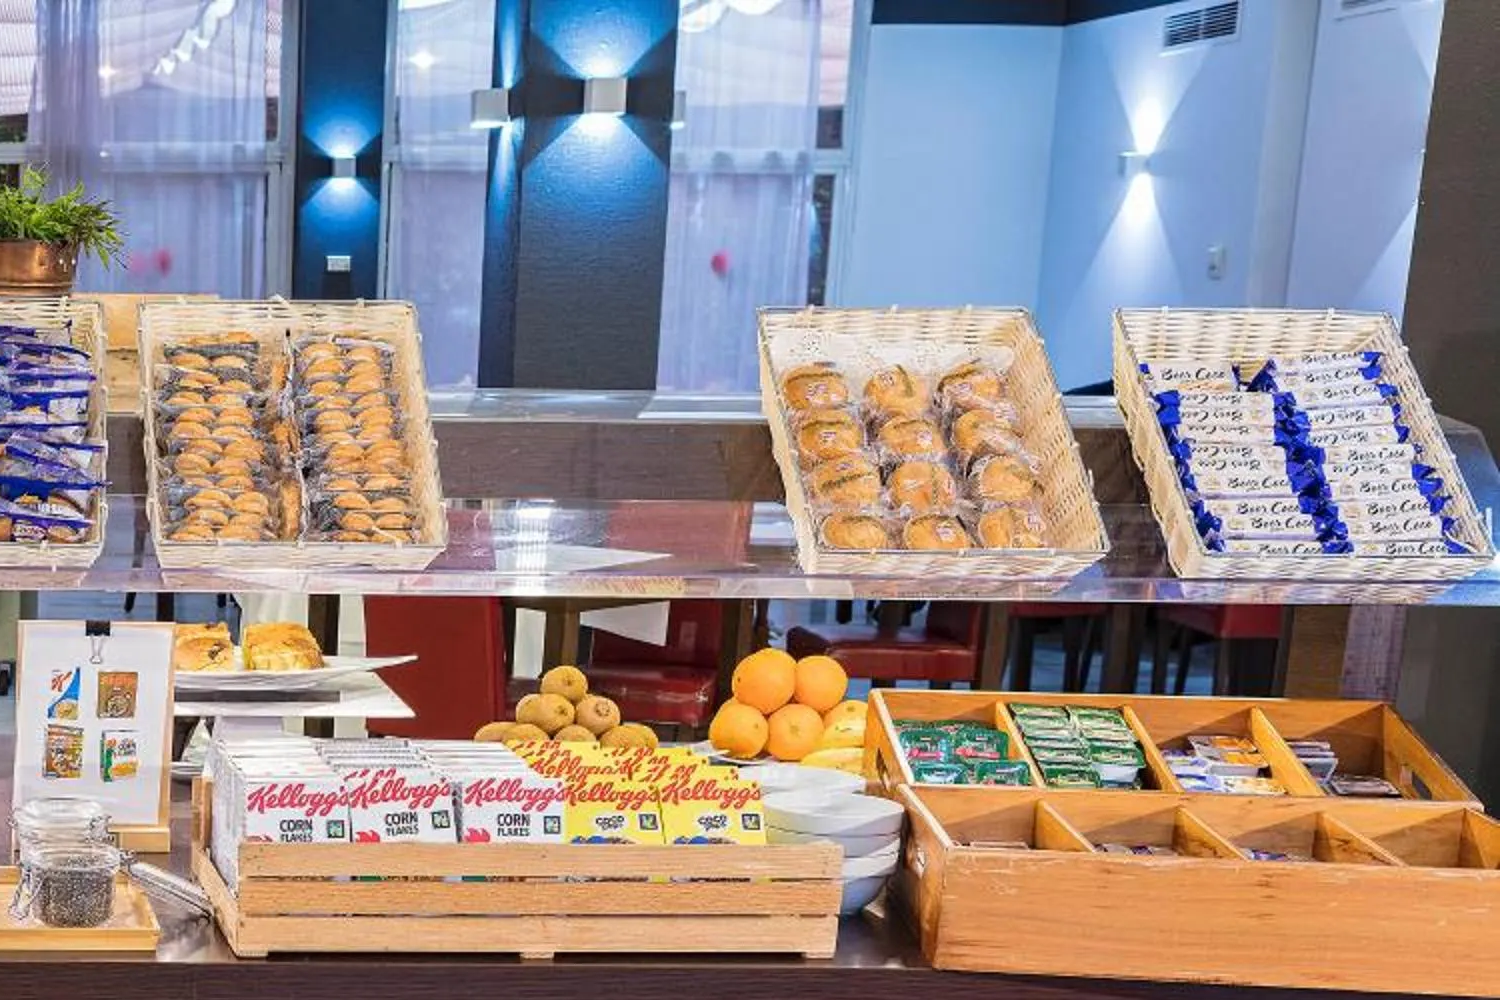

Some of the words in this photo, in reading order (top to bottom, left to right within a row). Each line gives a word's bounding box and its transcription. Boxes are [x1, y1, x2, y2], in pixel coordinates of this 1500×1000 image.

[247, 783, 350, 816] Kellogg's
[350, 777, 449, 809] Kellogg's
[463, 778, 565, 811] Kellogg's
[564, 781, 660, 810] Kellogg's
[661, 779, 761, 809] Kellogg's
[280, 819, 313, 832] CORN
[385, 811, 419, 827] CORN
[497, 813, 530, 826] CORN
